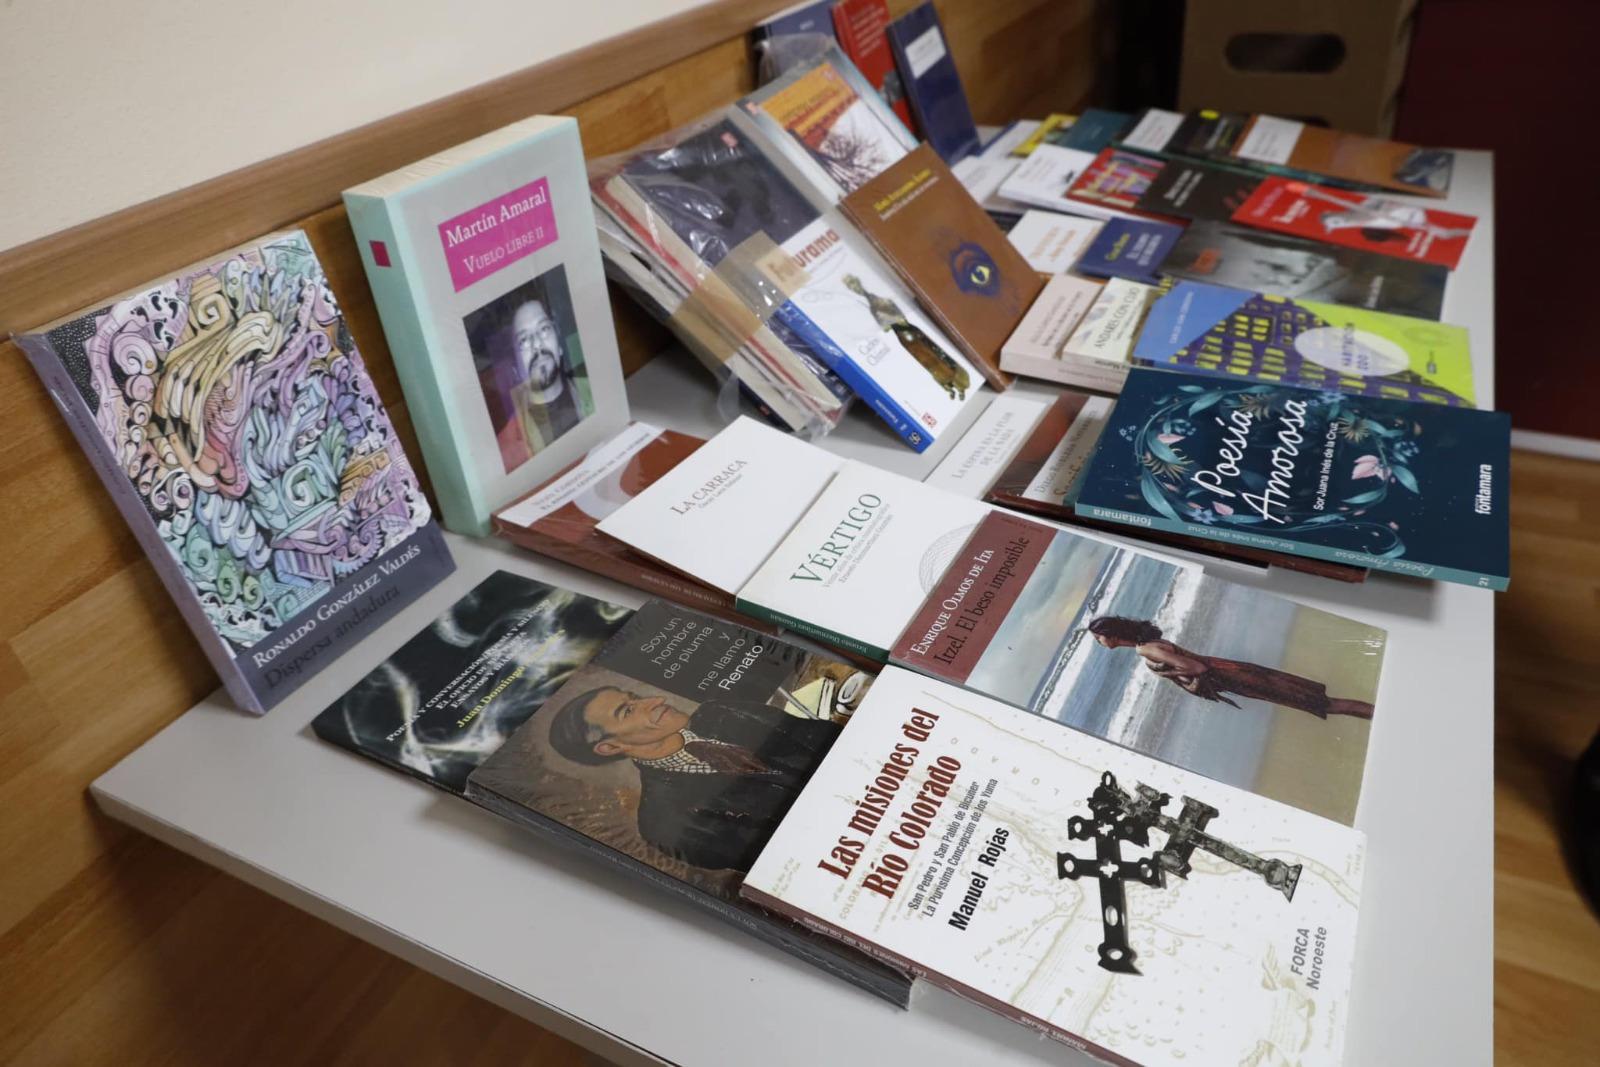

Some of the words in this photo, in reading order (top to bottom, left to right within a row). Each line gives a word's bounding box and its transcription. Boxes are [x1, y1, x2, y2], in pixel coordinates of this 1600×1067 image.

[500, 186, 547, 223] Amaral
[463, 247, 505, 273] VUELO
[506, 231, 535, 254] LIBRE
[1326, 422, 1338, 440] Cruz
[1190, 411, 1254, 498] Poesía
[1242, 399, 1308, 524] Amorosa
[1320, 459, 1332, 474] Inés
[1323, 448, 1334, 458] de
[670, 500, 696, 515] LA
[692, 460, 748, 501] CARRACA
[1316, 475, 1329, 497] Juana
[1475, 463, 1492, 515] fontamara
[1093, 508, 1152, 527] fontamara
[1313, 497, 1325, 511] Sor
[789, 493, 882, 581] VÉRTIGO
[1188, 526, 1208, 535] Cruz
[1219, 530, 1230, 538] de
[1251, 537, 1278, 547] Juana
[969, 564, 984, 578] DE
[974, 549, 995, 569] ITA
[942, 577, 975, 611] OLMOS
[955, 608, 978, 633] El
[969, 590, 995, 616] beso
[984, 536, 1030, 591] imposible
[252, 619, 317, 669] RONALDO
[317, 574, 381, 622] GONZÁLEZ
[378, 544, 421, 576] VALDÉS
[264, 635, 333, 689] Dispersa
[336, 585, 400, 639] andadura
[640, 631, 668, 653] Soy
[664, 617, 682, 631] un
[651, 621, 697, 665] hombre
[719, 632, 731, 641] y
[910, 612, 951, 656] ENRIQUE
[663, 662, 681, 679] de
[679, 626, 714, 663] pluma
[697, 670, 719, 691] me
[713, 638, 746, 669] llamo
[718, 645, 763, 691] Renato
[456, 704, 484, 728] Juan
[480, 665, 526, 705] Domingo
[818, 835, 866, 880] Las
[848, 743, 920, 837] misiones
[901, 707, 940, 742] del
[981, 778, 999, 799] Yuma
[955, 810, 966, 821] de
[970, 811, 981, 822] de
[974, 799, 988, 816] los
[861, 853, 909, 899] Río
[889, 755, 962, 850] Colorado
[942, 820, 961, 843] Pablo
[932, 858, 942, 866] y
[934, 842, 950, 859] San
[916, 866, 938, 893] Pedro
[948, 871, 989, 932] Manuel
[978, 827, 1009, 868] Rojas
[907, 892, 925, 910] San
[922, 905, 936, 917] La
[1290, 928, 1310, 976] FORCA
[1306, 926, 1328, 990] Noroeste
